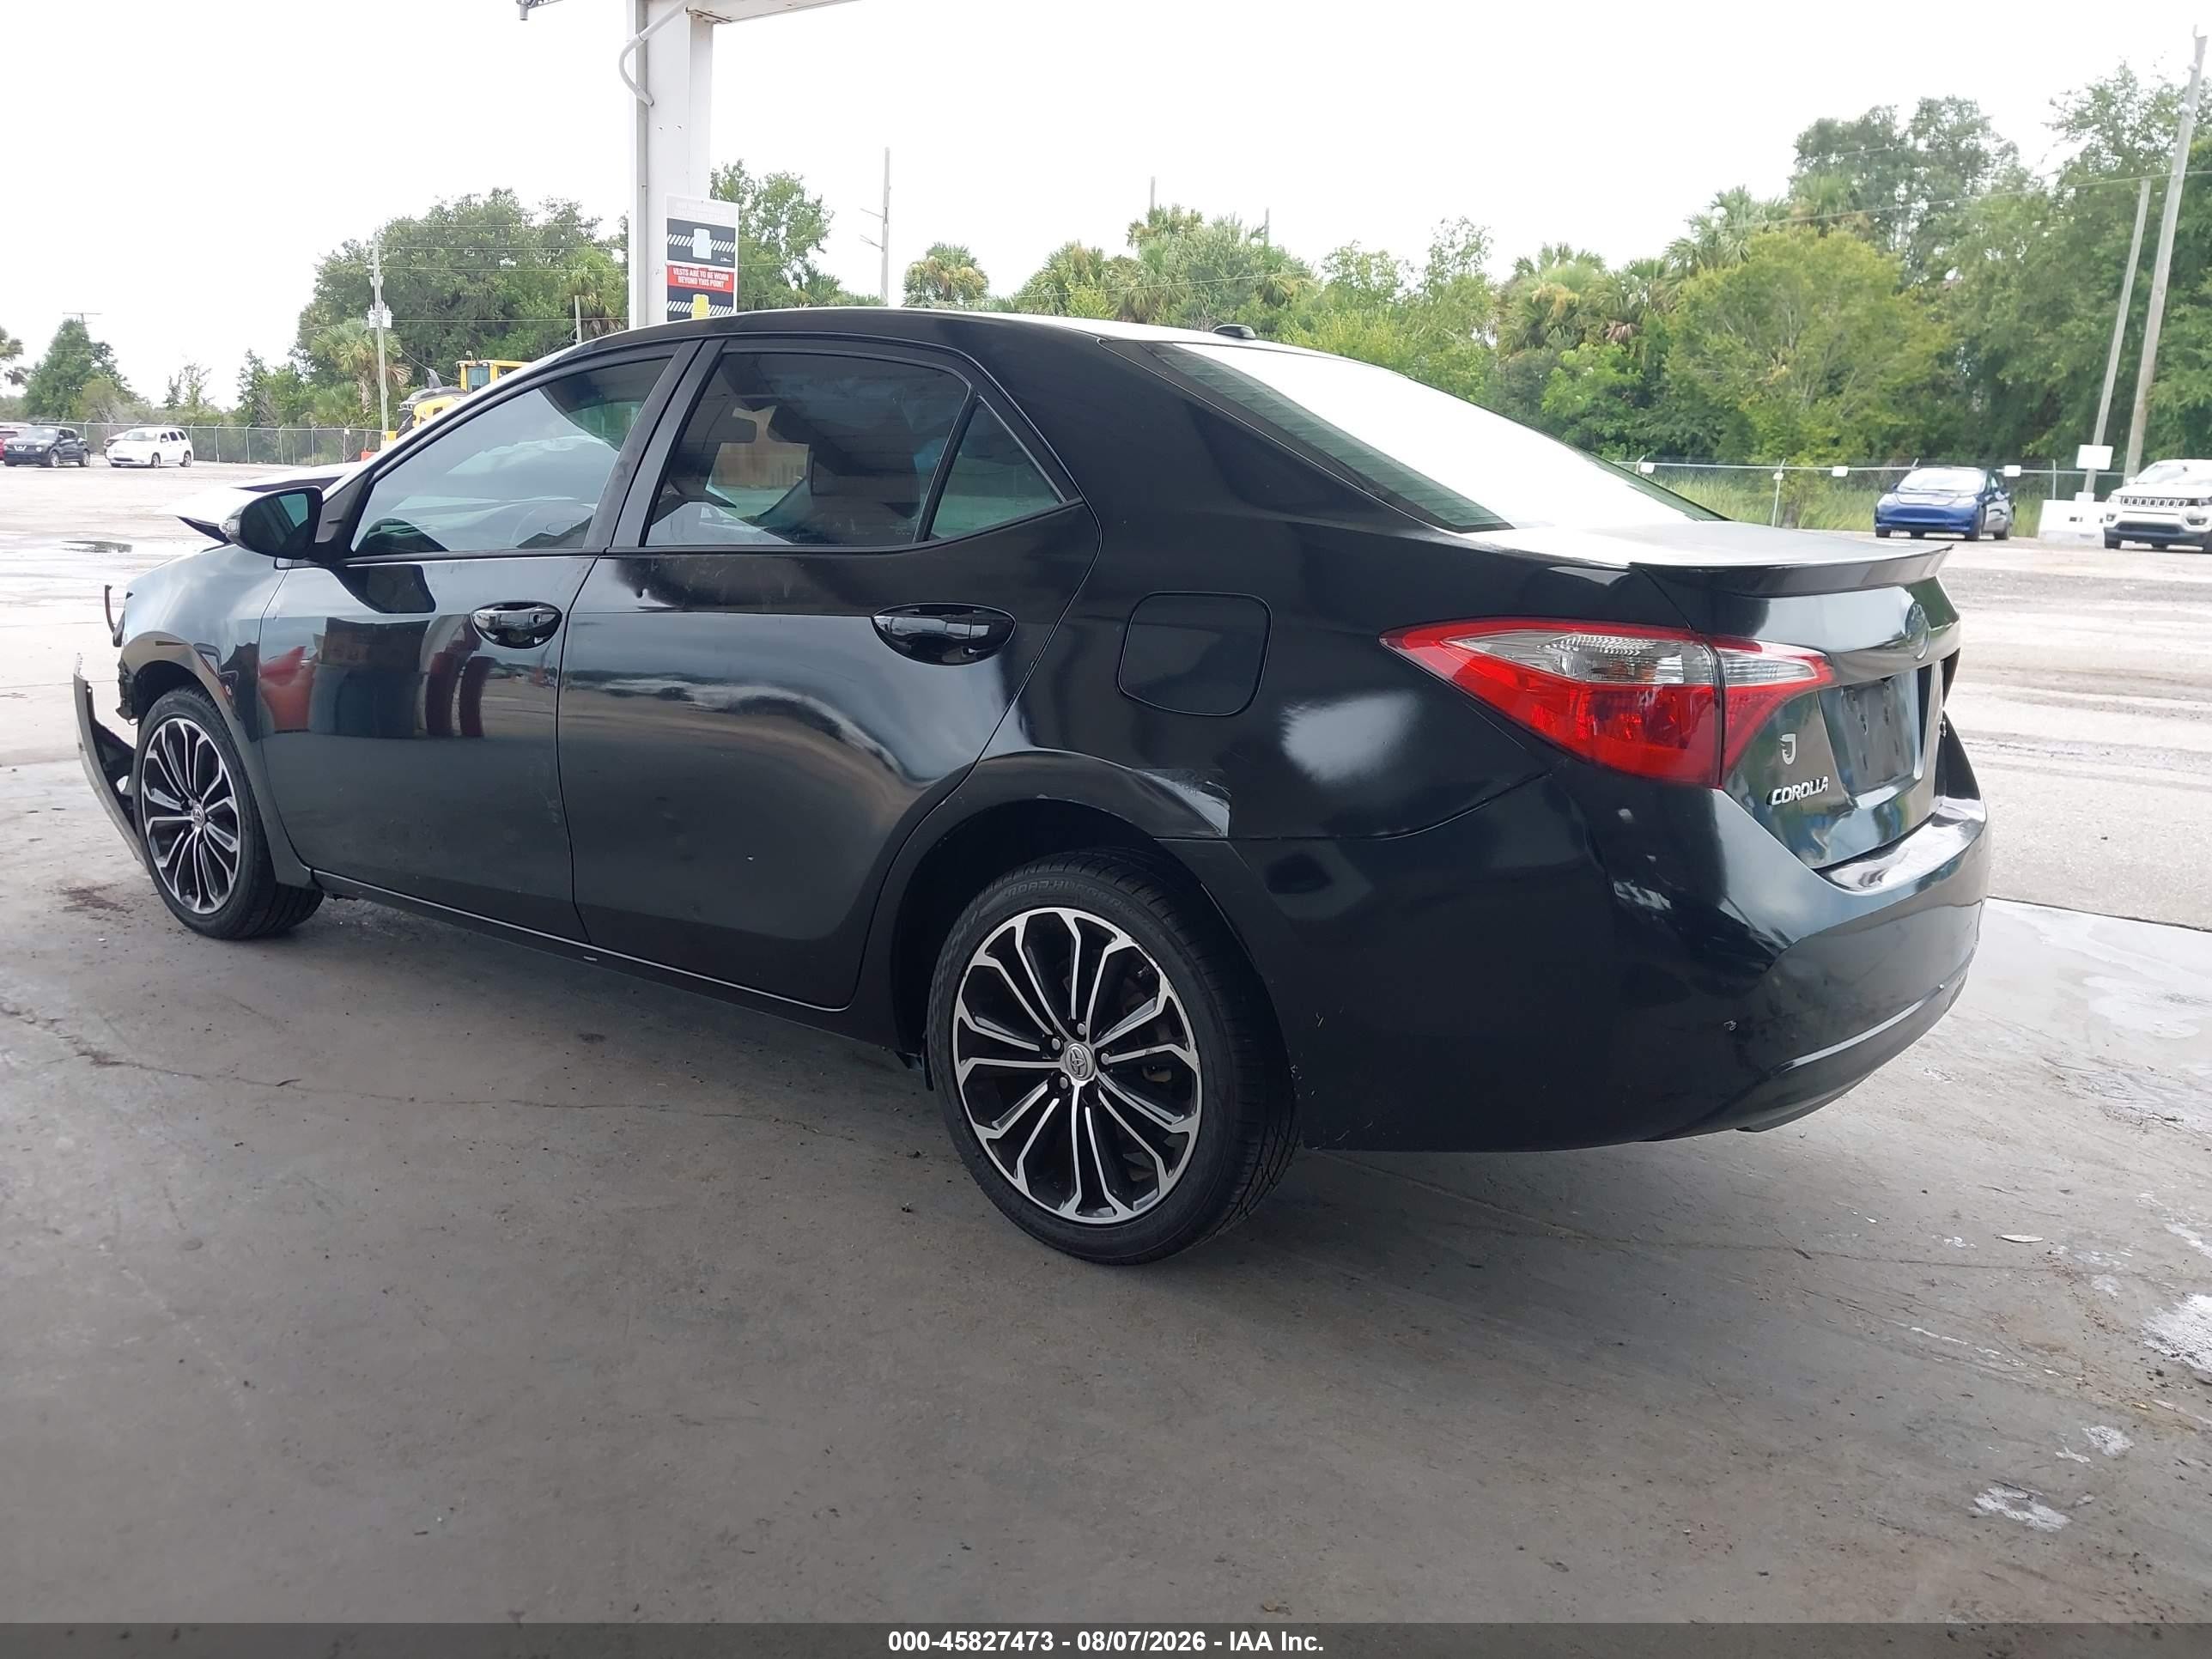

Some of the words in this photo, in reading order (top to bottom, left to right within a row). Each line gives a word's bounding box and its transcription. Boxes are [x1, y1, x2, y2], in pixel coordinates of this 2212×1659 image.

[673, 267, 689, 276] VESTS
[690, 269, 699, 277] ARE
[714, 272, 729, 282] WORN
[678, 276, 698, 285] BEYOND
[710, 280, 725, 289] POINT
[1771, 775, 1830, 806] COROLLA
